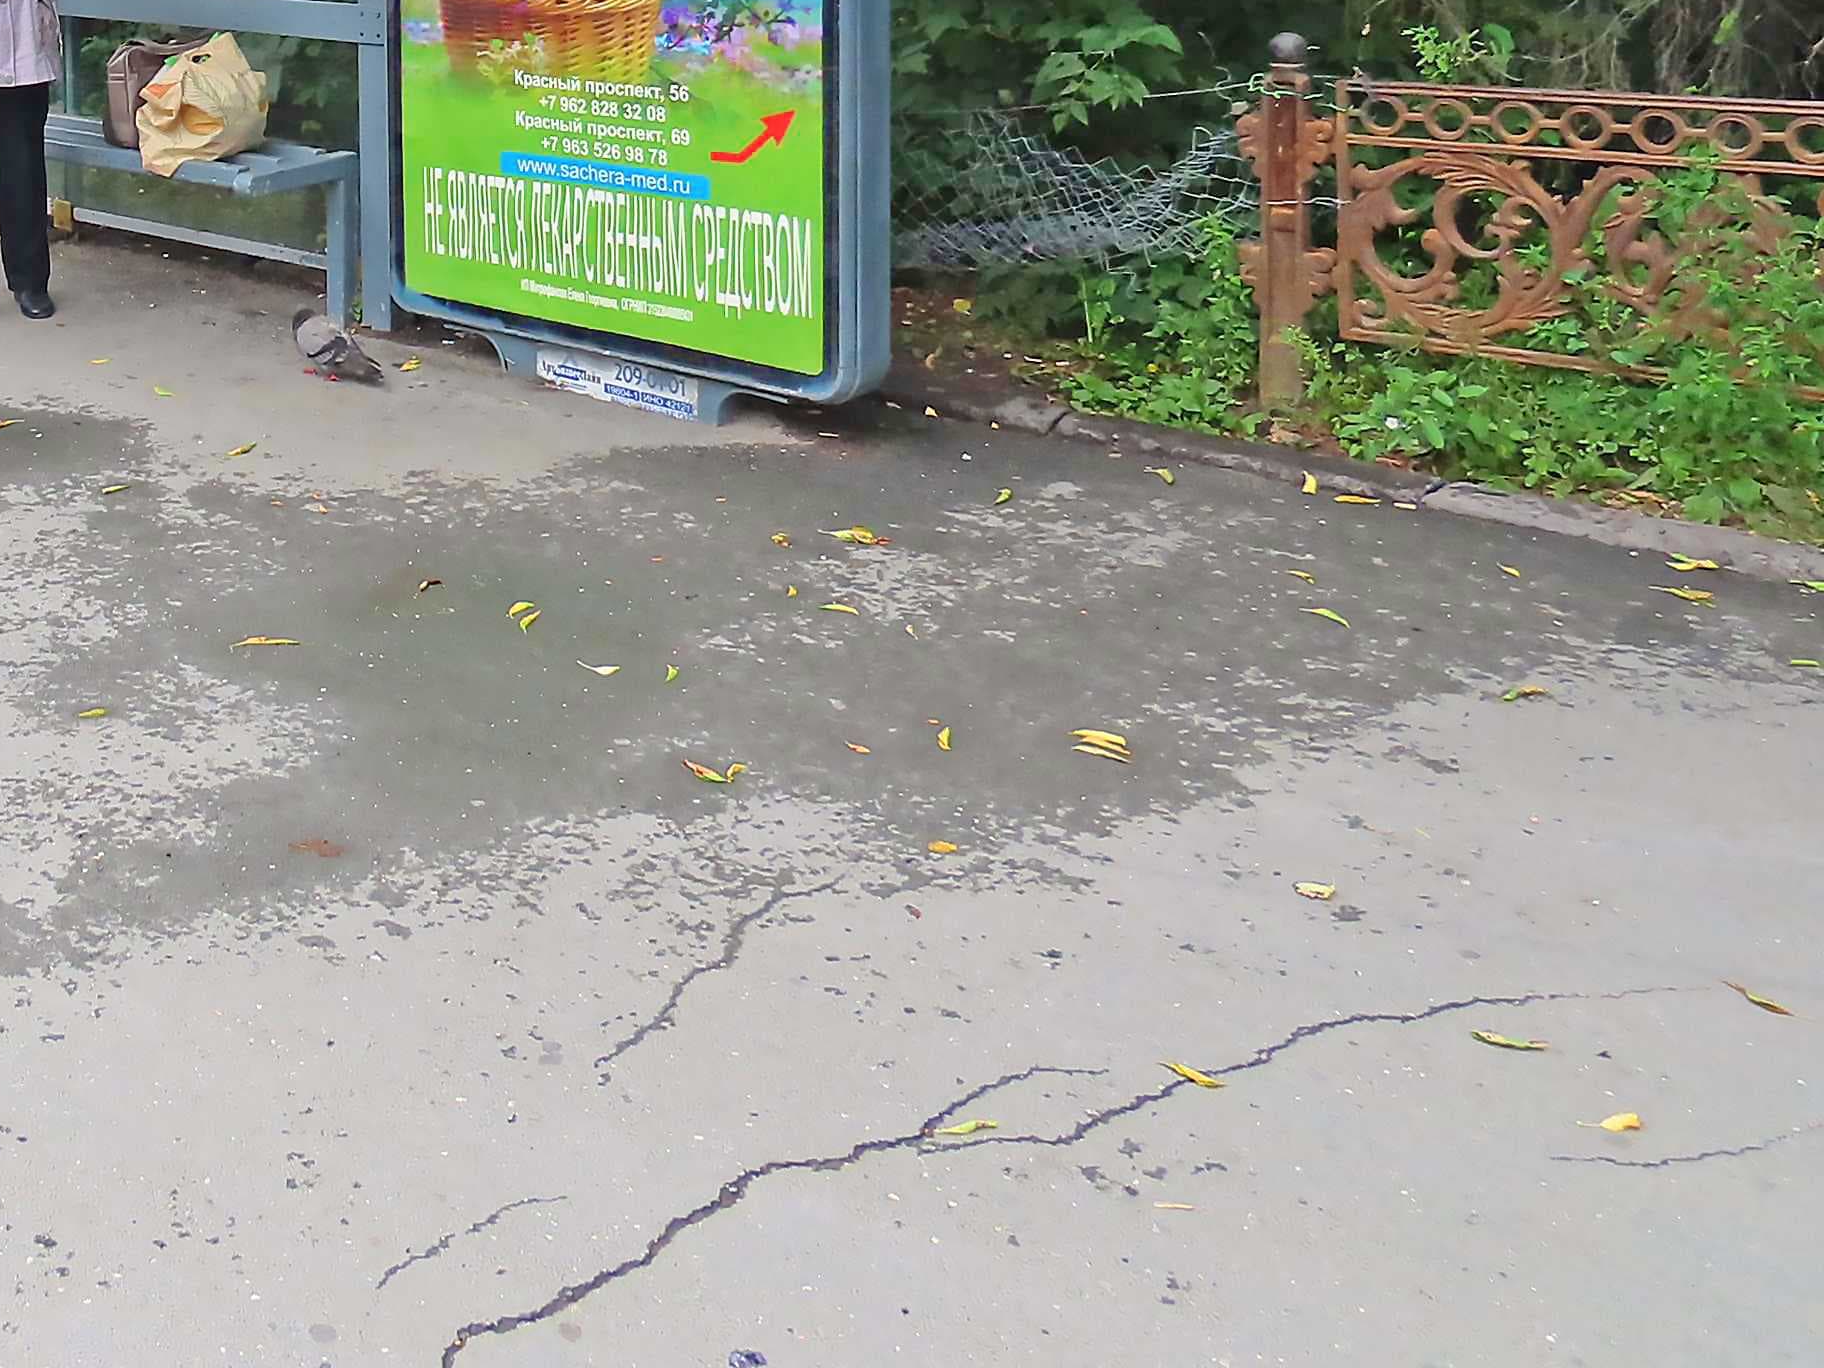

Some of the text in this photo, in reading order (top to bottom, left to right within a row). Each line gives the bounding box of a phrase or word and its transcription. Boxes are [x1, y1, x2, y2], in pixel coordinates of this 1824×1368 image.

[513, 69, 690, 103] Красный проспект, 56
[538, 94, 667, 123] +7 962 828 32 08
[514, 110, 691, 146] Красный проспект, 69
[541, 135, 668, 166] +7 963 526 98 78
[516, 157, 691, 195] www.sachera-med.ru
[423, 166, 814, 321] НЕ ЯВЛЯЕТСЯ ЛЕКАРСТВЕННЫМ СРЕДСТВОМ
